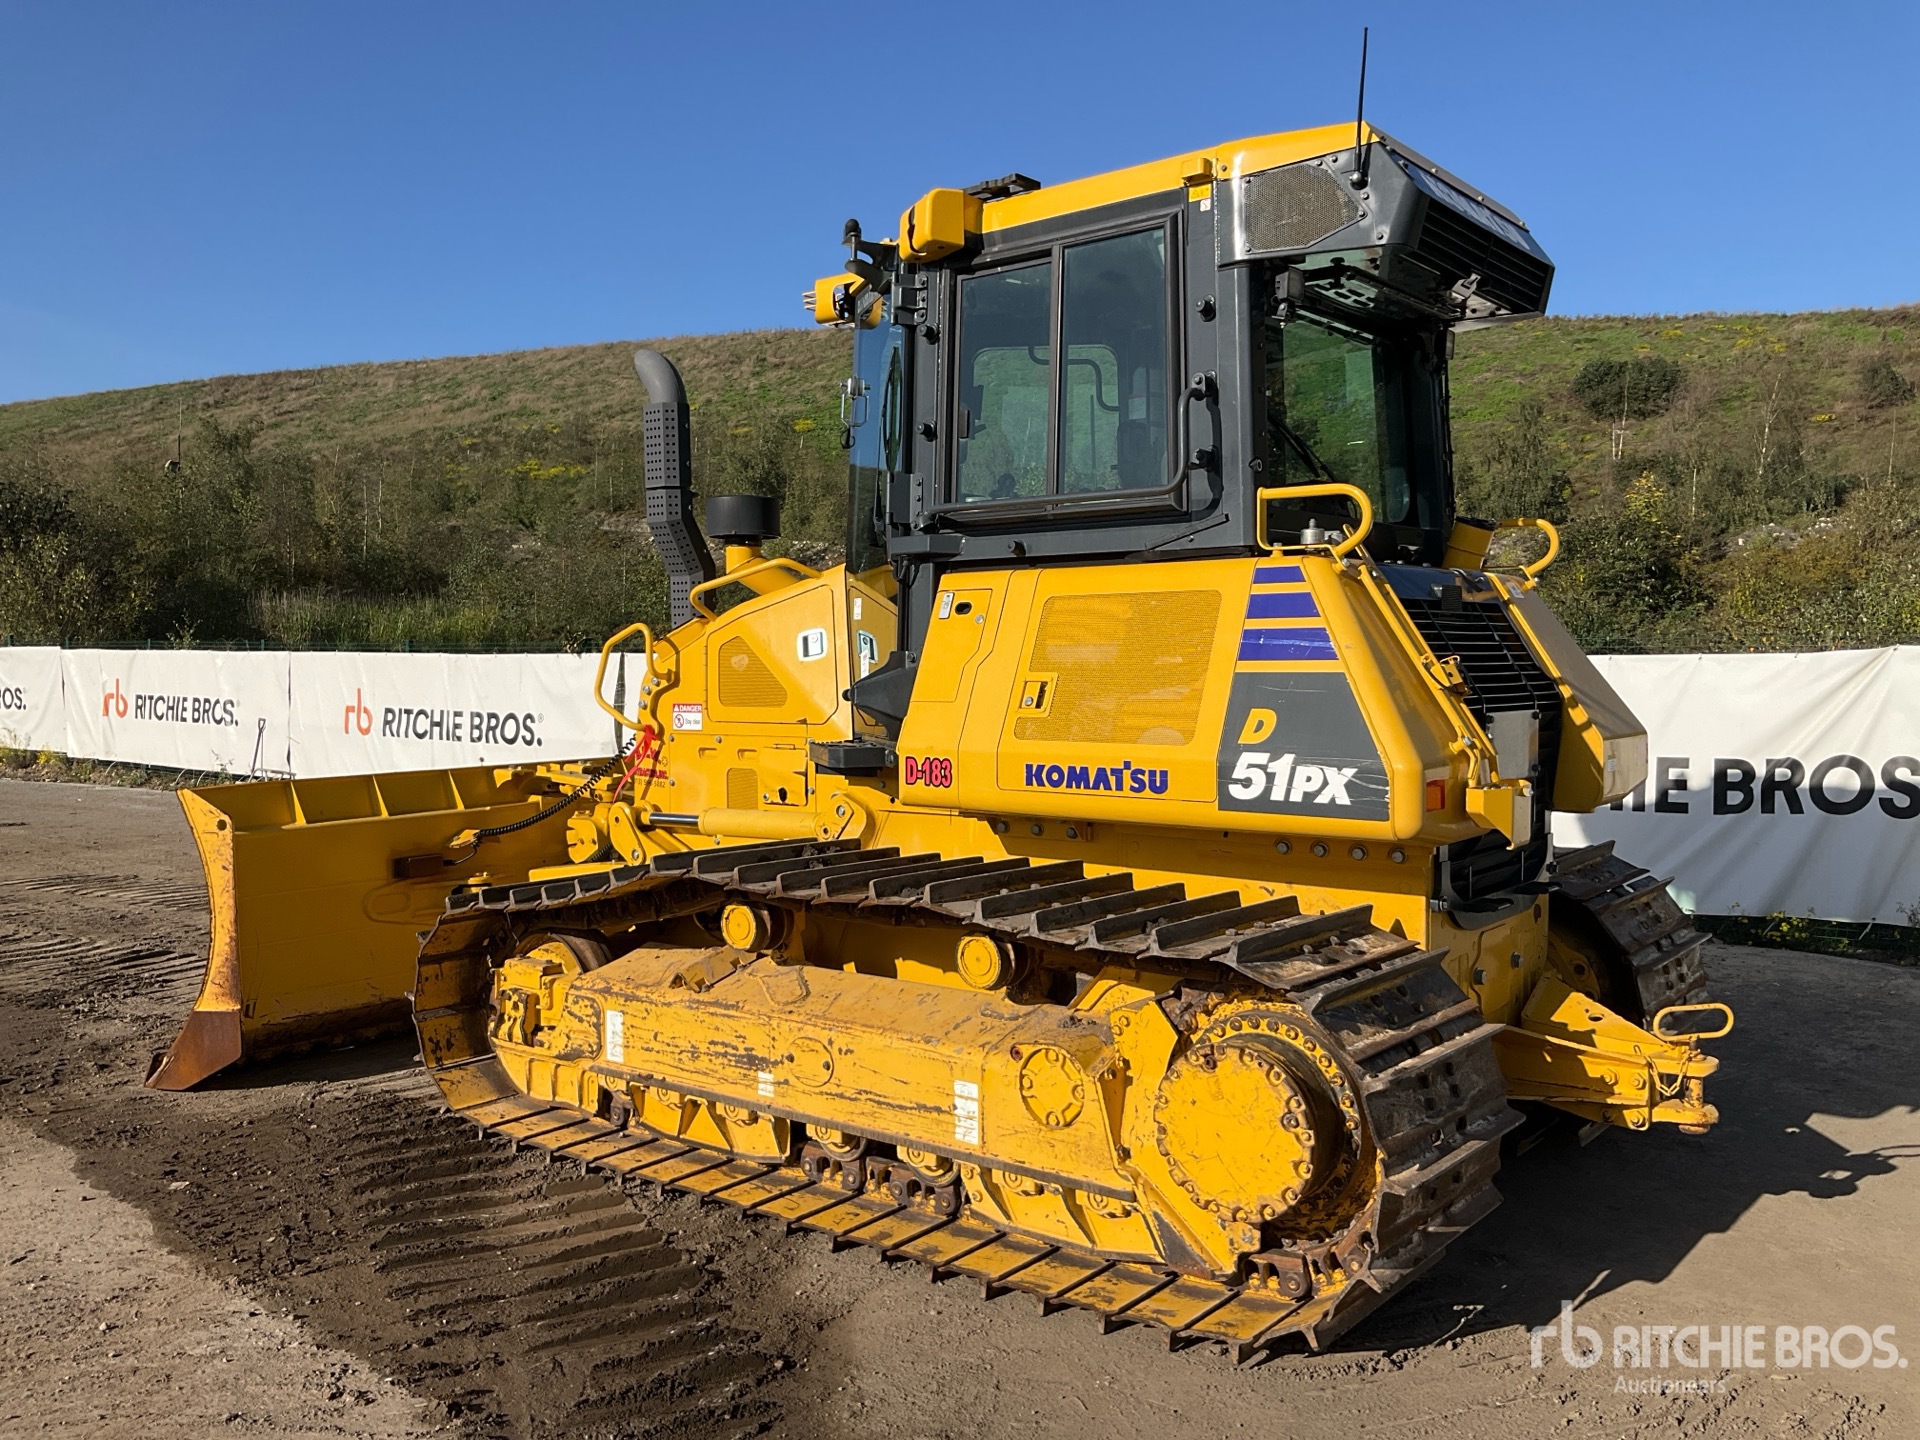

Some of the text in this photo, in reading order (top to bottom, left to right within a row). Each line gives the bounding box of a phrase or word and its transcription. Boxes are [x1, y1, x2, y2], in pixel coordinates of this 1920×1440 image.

[0, 686, 27, 711] OS.
[135, 693, 188, 723] RITCHIE
[679, 705, 702, 713] DANGER
[382, 707, 464, 742] RITCHIE
[1237, 708, 1278, 745] D
[905, 756, 952, 788] D-183
[1025, 760, 1169, 795] KOMATSU
[1228, 751, 1358, 806] 51PX
